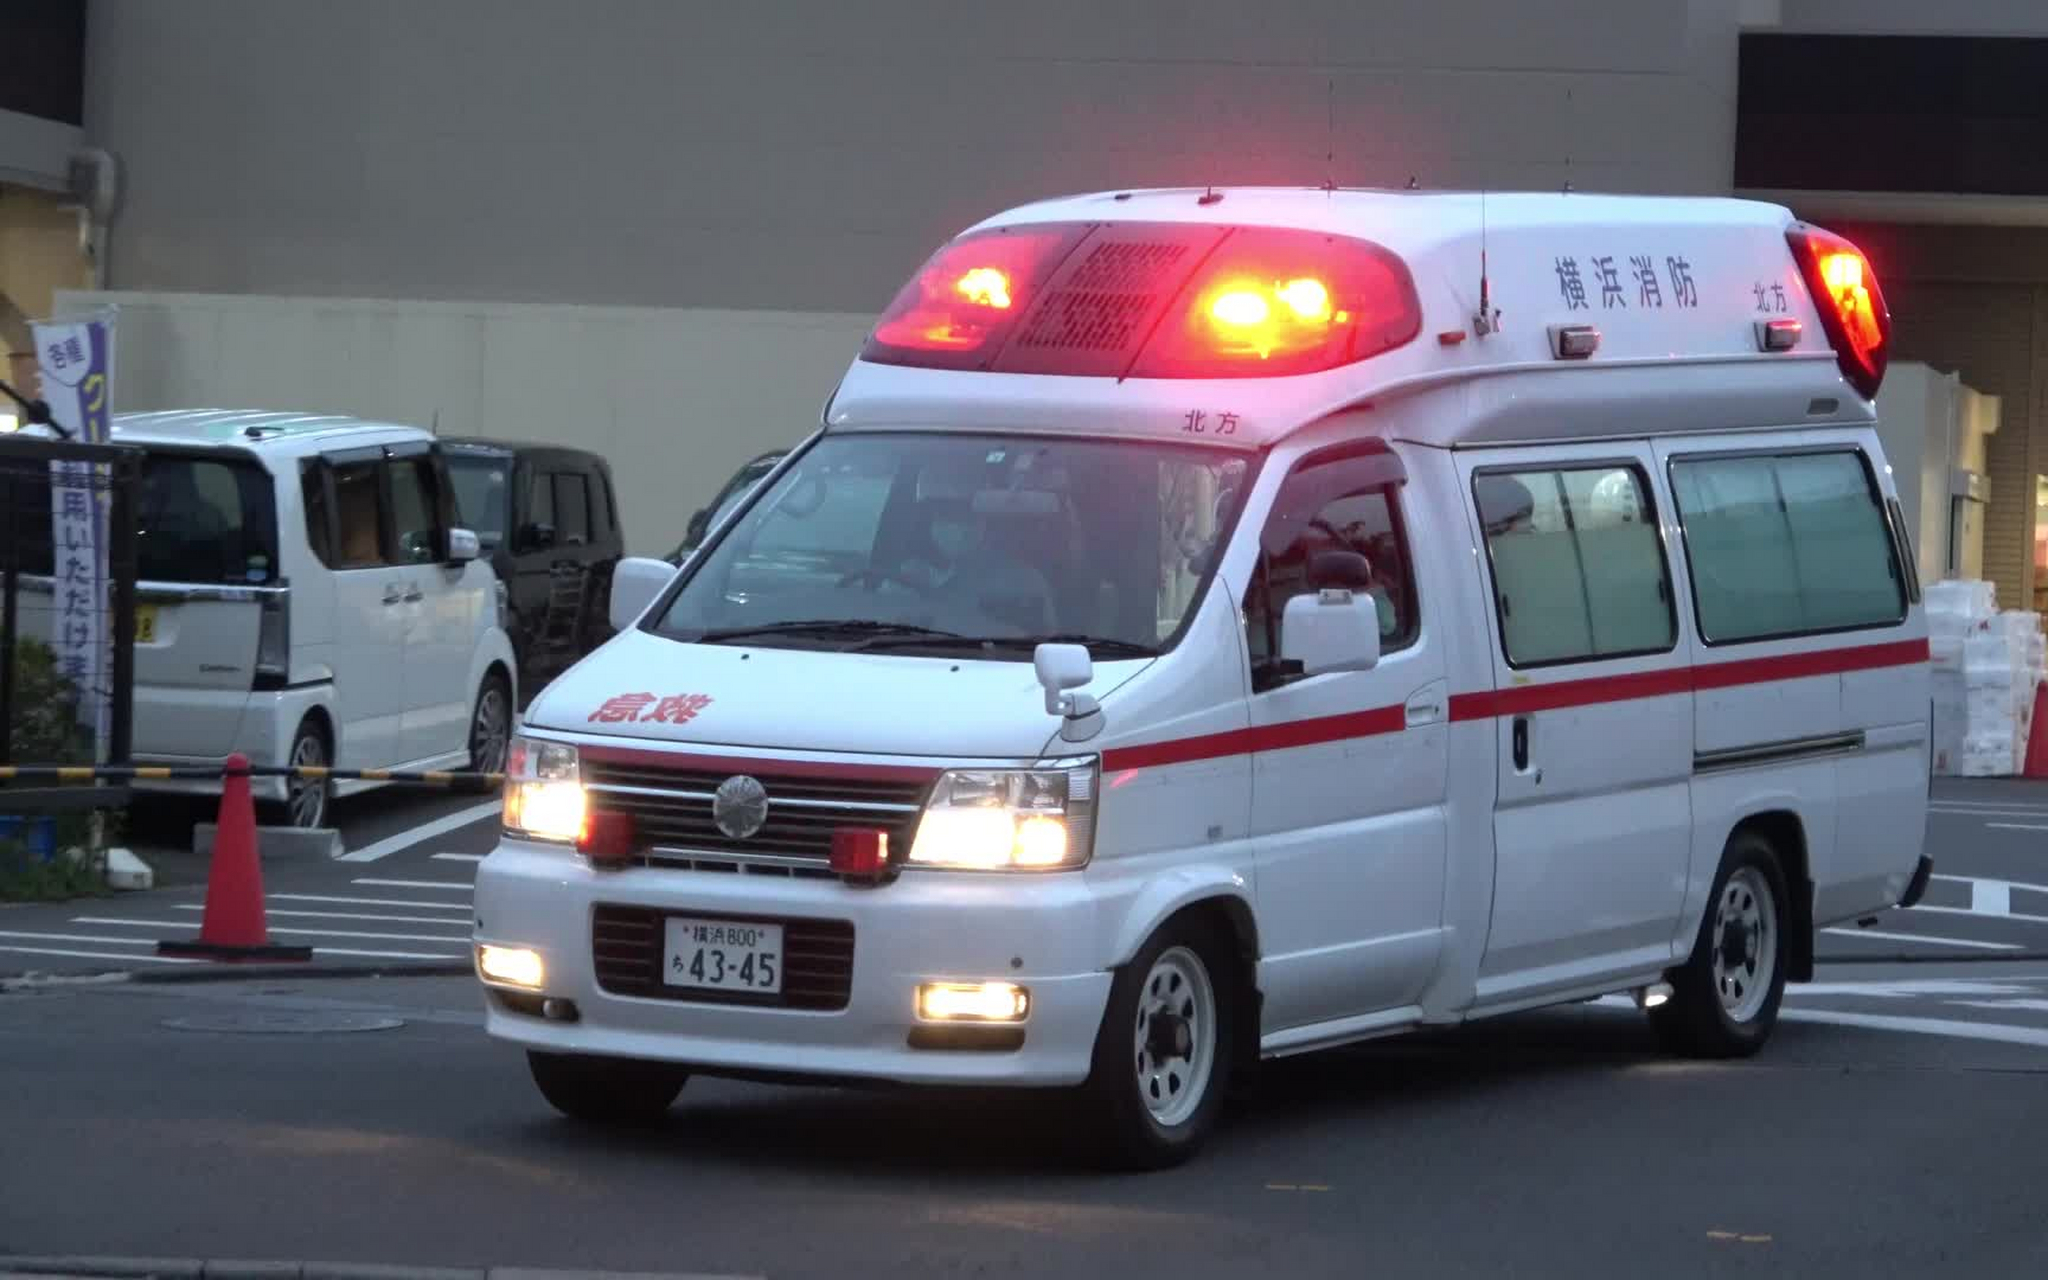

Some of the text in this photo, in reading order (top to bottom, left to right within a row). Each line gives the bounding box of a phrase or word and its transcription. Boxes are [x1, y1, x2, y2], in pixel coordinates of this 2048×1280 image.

[1555, 255, 1698, 310] 横浜消防
[1753, 281, 1788, 313] 北方
[1181, 409, 1240, 434] 北方
[690, 948, 776, 987] 43-45
